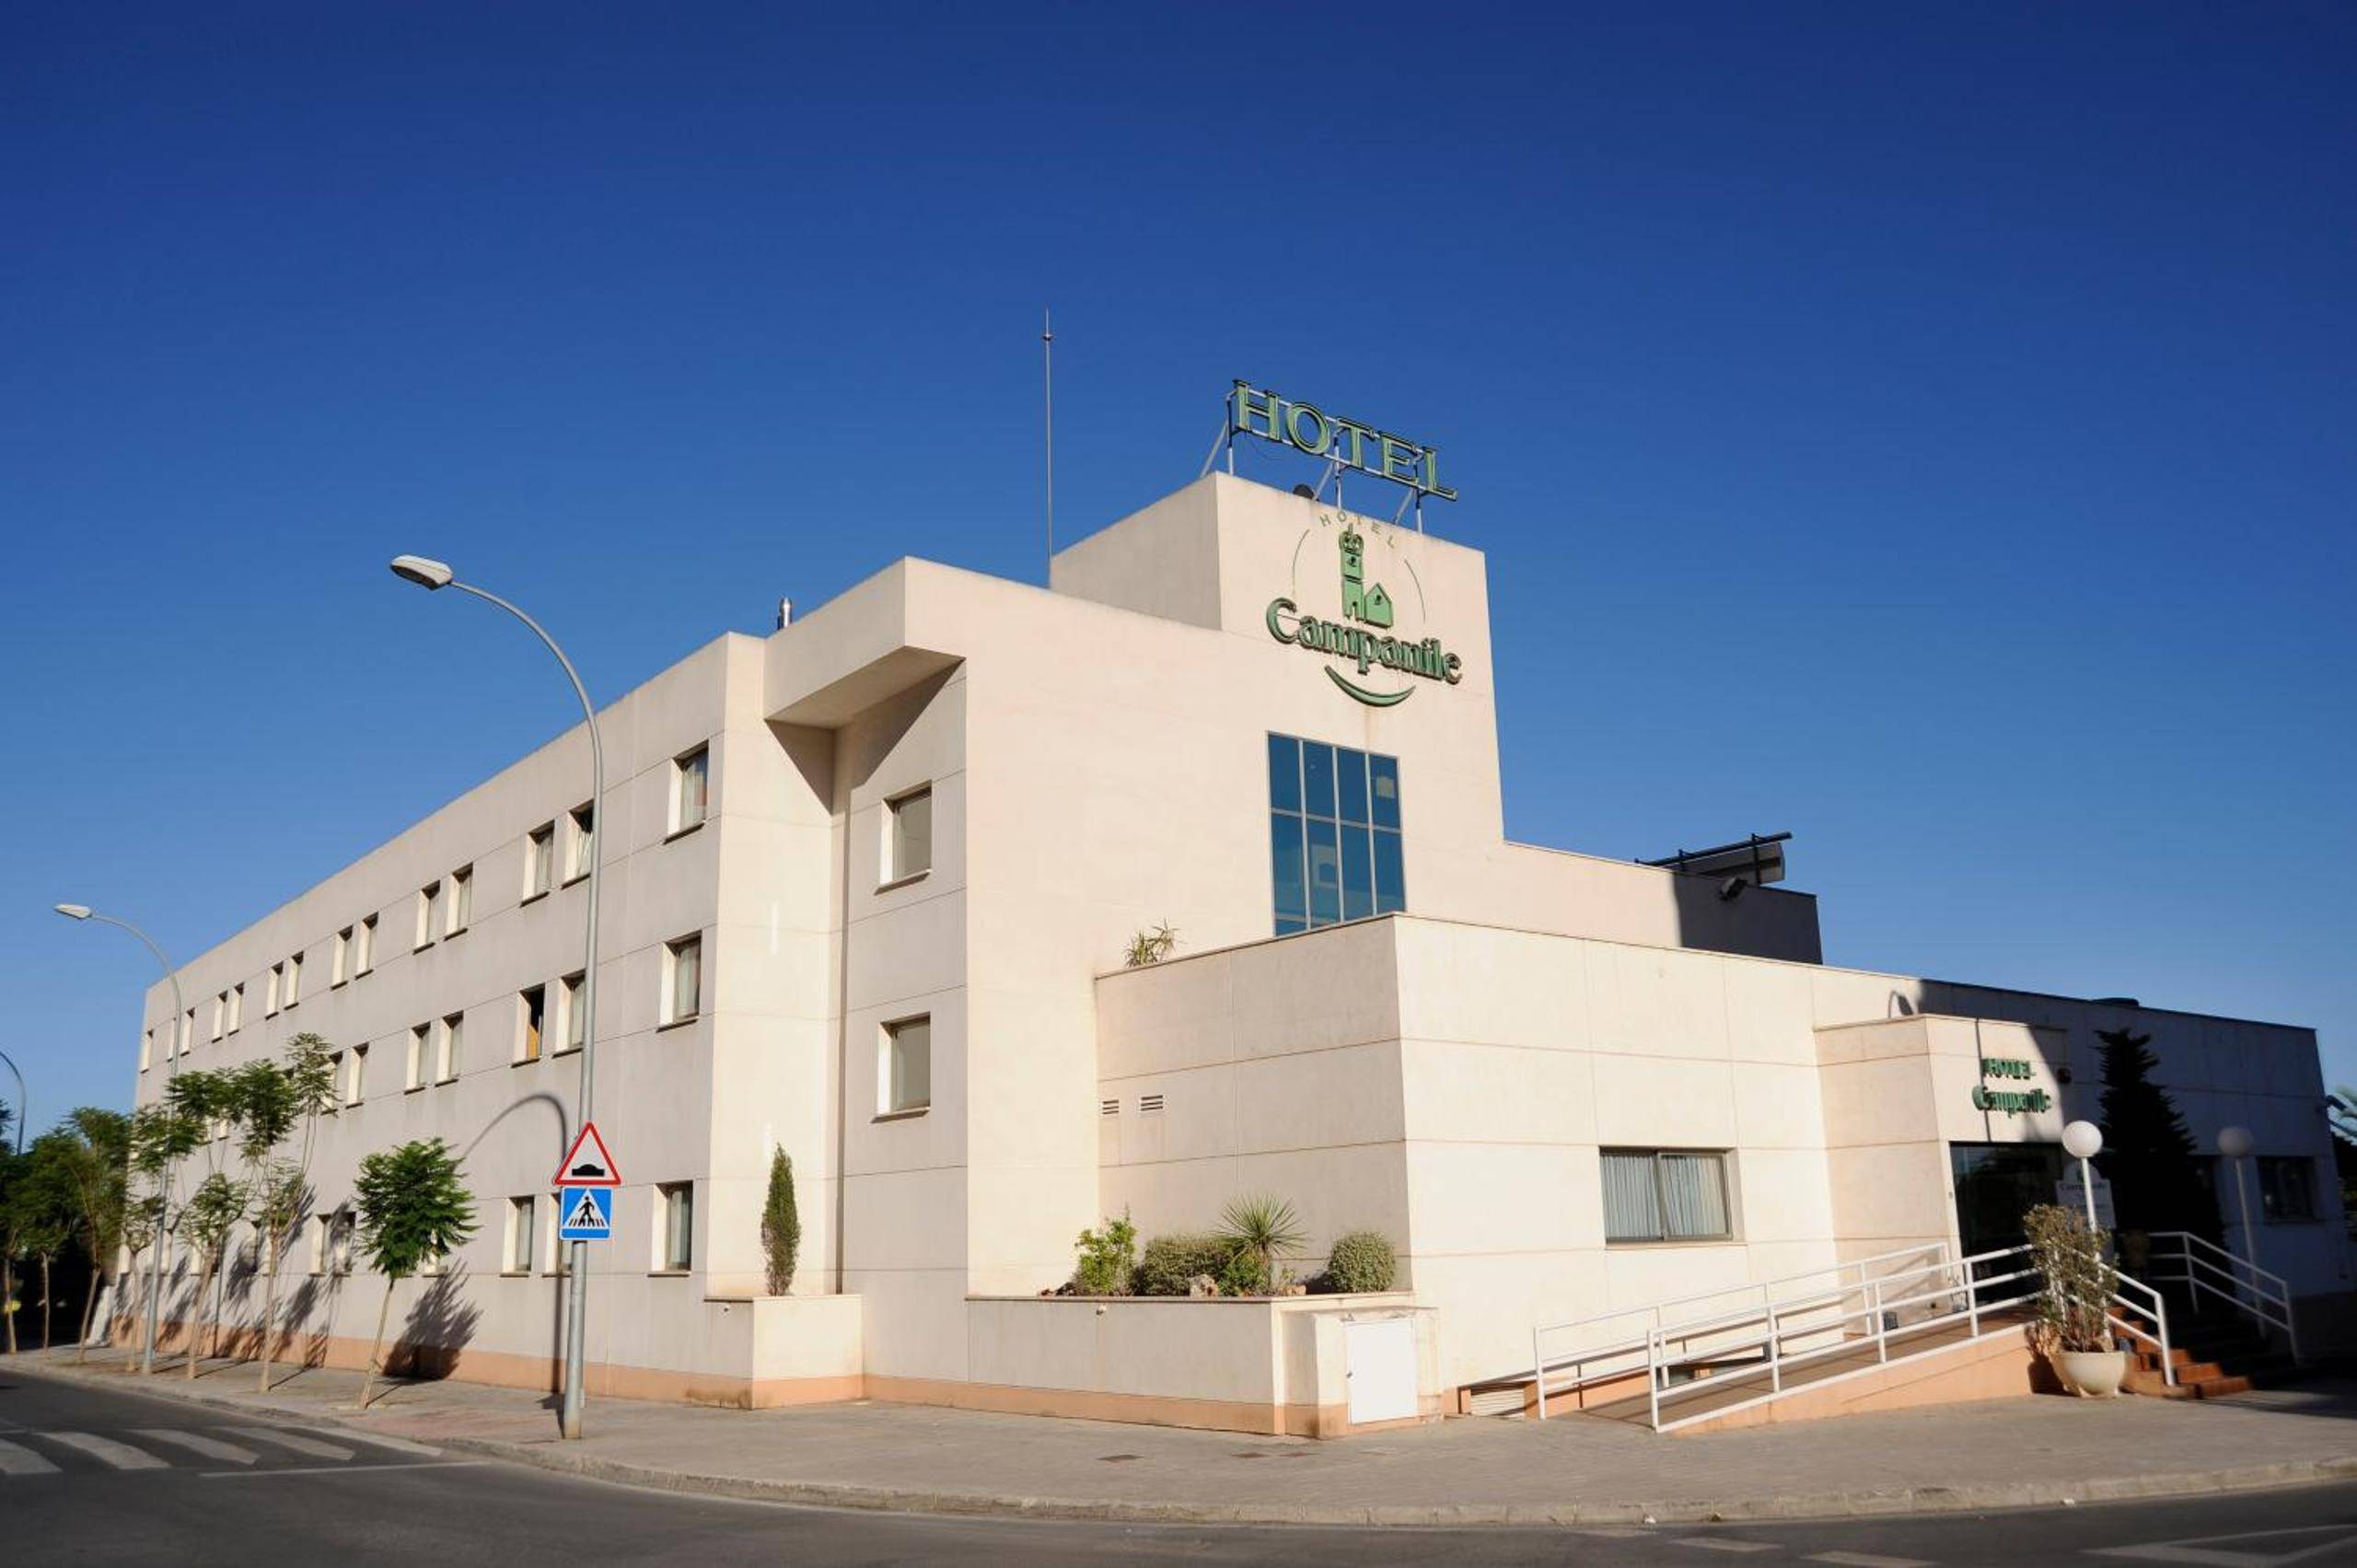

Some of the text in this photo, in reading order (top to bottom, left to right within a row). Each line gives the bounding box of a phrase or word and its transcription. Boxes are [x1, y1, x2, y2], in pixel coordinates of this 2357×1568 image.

[1232, 379, 1458, 501] HOTEL
[1319, 510, 1395, 549] HOTEL
[1266, 597, 1463, 685] Campanile
[1981, 1059, 2037, 1080] HOTEL
[1972, 1085, 2051, 1119] Campanile
